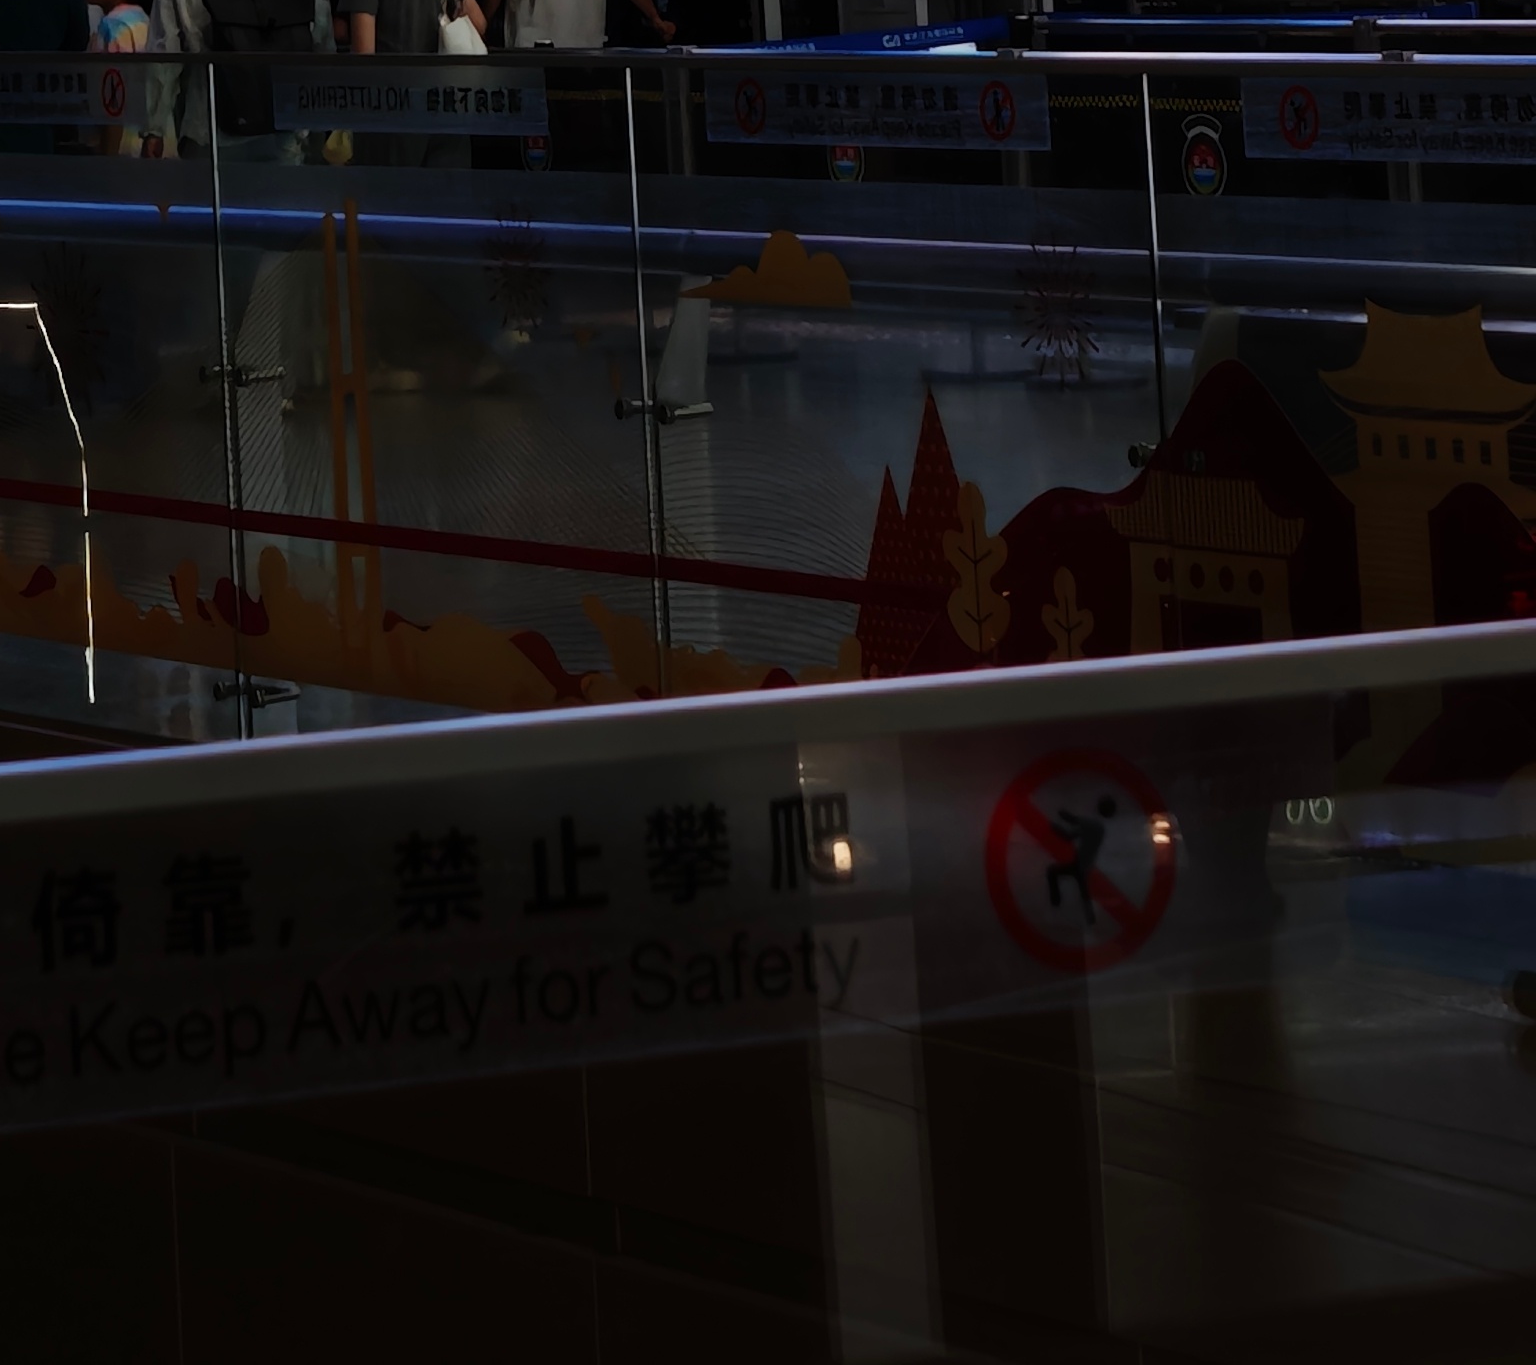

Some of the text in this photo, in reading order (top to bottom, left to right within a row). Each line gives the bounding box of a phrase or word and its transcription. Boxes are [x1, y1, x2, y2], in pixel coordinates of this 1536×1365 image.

[69, 998, 266, 1078] Keep
[287, 978, 489, 1053] Away
[515, 953, 610, 1025] for
[630, 927, 860, 1012] Safety
